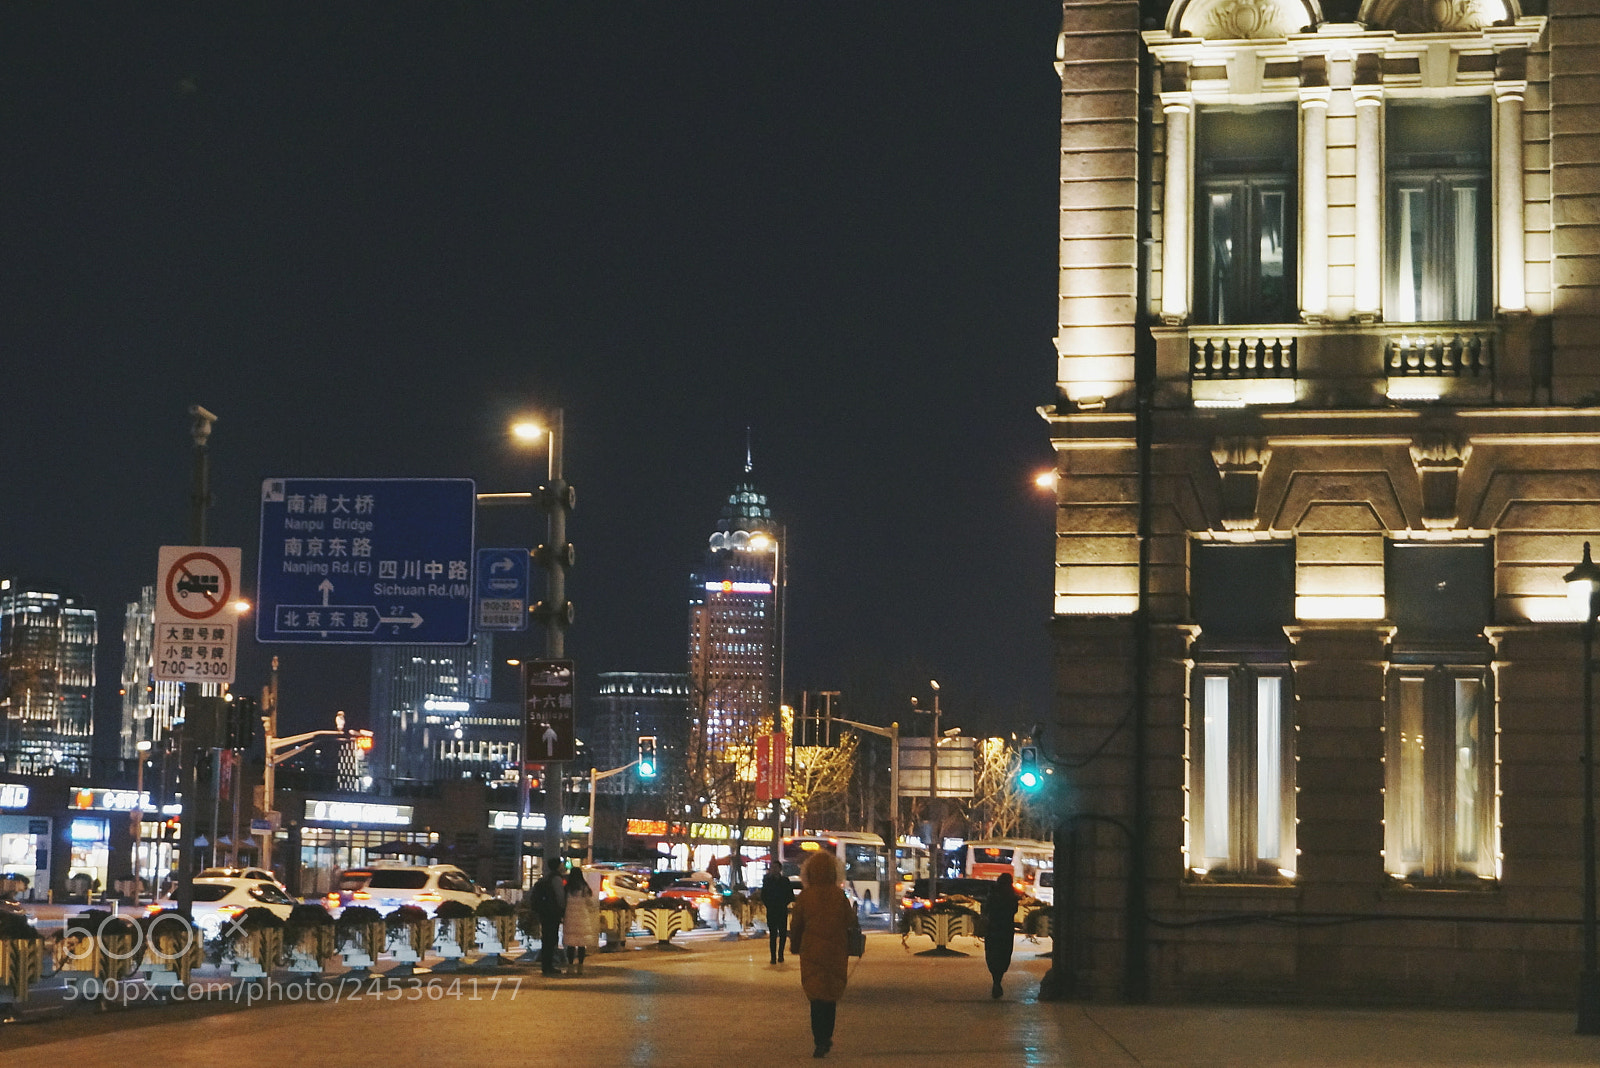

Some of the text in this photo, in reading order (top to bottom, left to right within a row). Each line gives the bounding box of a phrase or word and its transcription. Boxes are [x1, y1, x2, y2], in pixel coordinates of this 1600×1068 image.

[287, 493, 374, 514] 南浦大桥
[284, 517, 373, 533] Nanpu Bridge
[284, 537, 372, 557] 南京东路
[282, 561, 372, 576] Nanjing Rd.(E)
[379, 560, 467, 580] 四川中路
[373, 583, 426, 596] Sichuan
[283, 610, 369, 628] 北京东路
[166, 627, 225, 641] 大型号牌
[165, 645, 224, 660] 小型号牌
